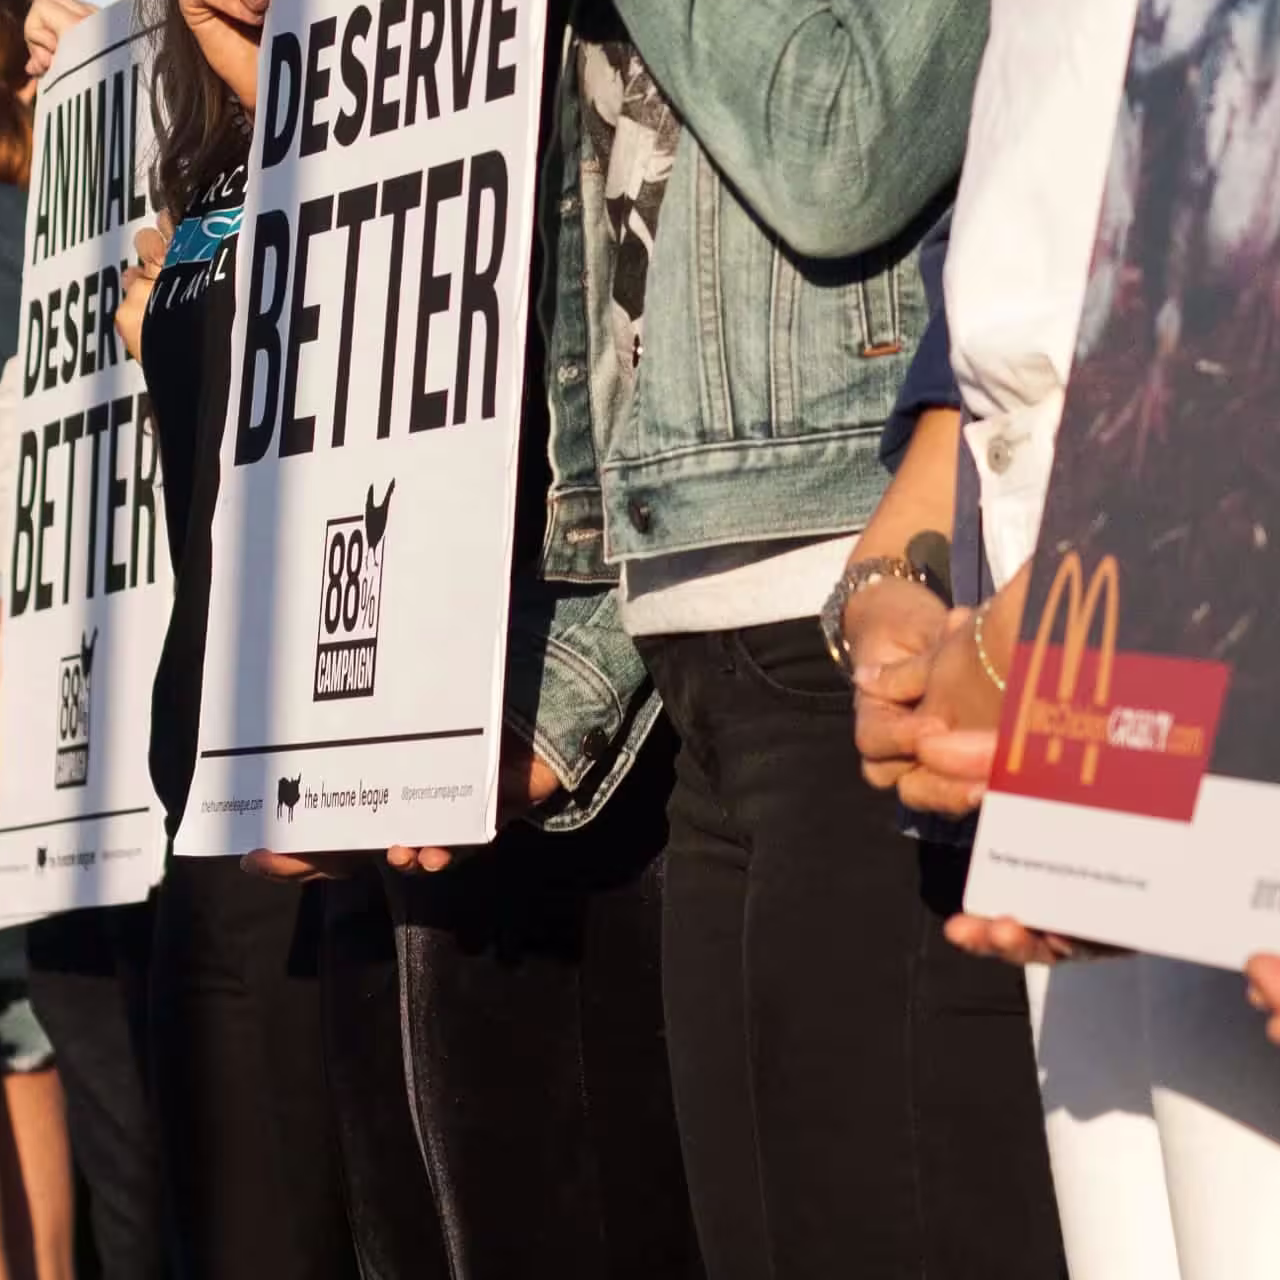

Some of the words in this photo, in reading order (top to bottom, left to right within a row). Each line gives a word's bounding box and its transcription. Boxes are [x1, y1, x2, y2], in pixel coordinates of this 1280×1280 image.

[234, 150, 510, 466] BETTER
[10, 391, 159, 618] BETTER
[325, 528, 375, 634] 88%
[317, 645, 375, 695] CAMPAIGN
[304, 786, 318, 810] the
[320, 780, 356, 810] humane
[358, 778, 389, 813] league
